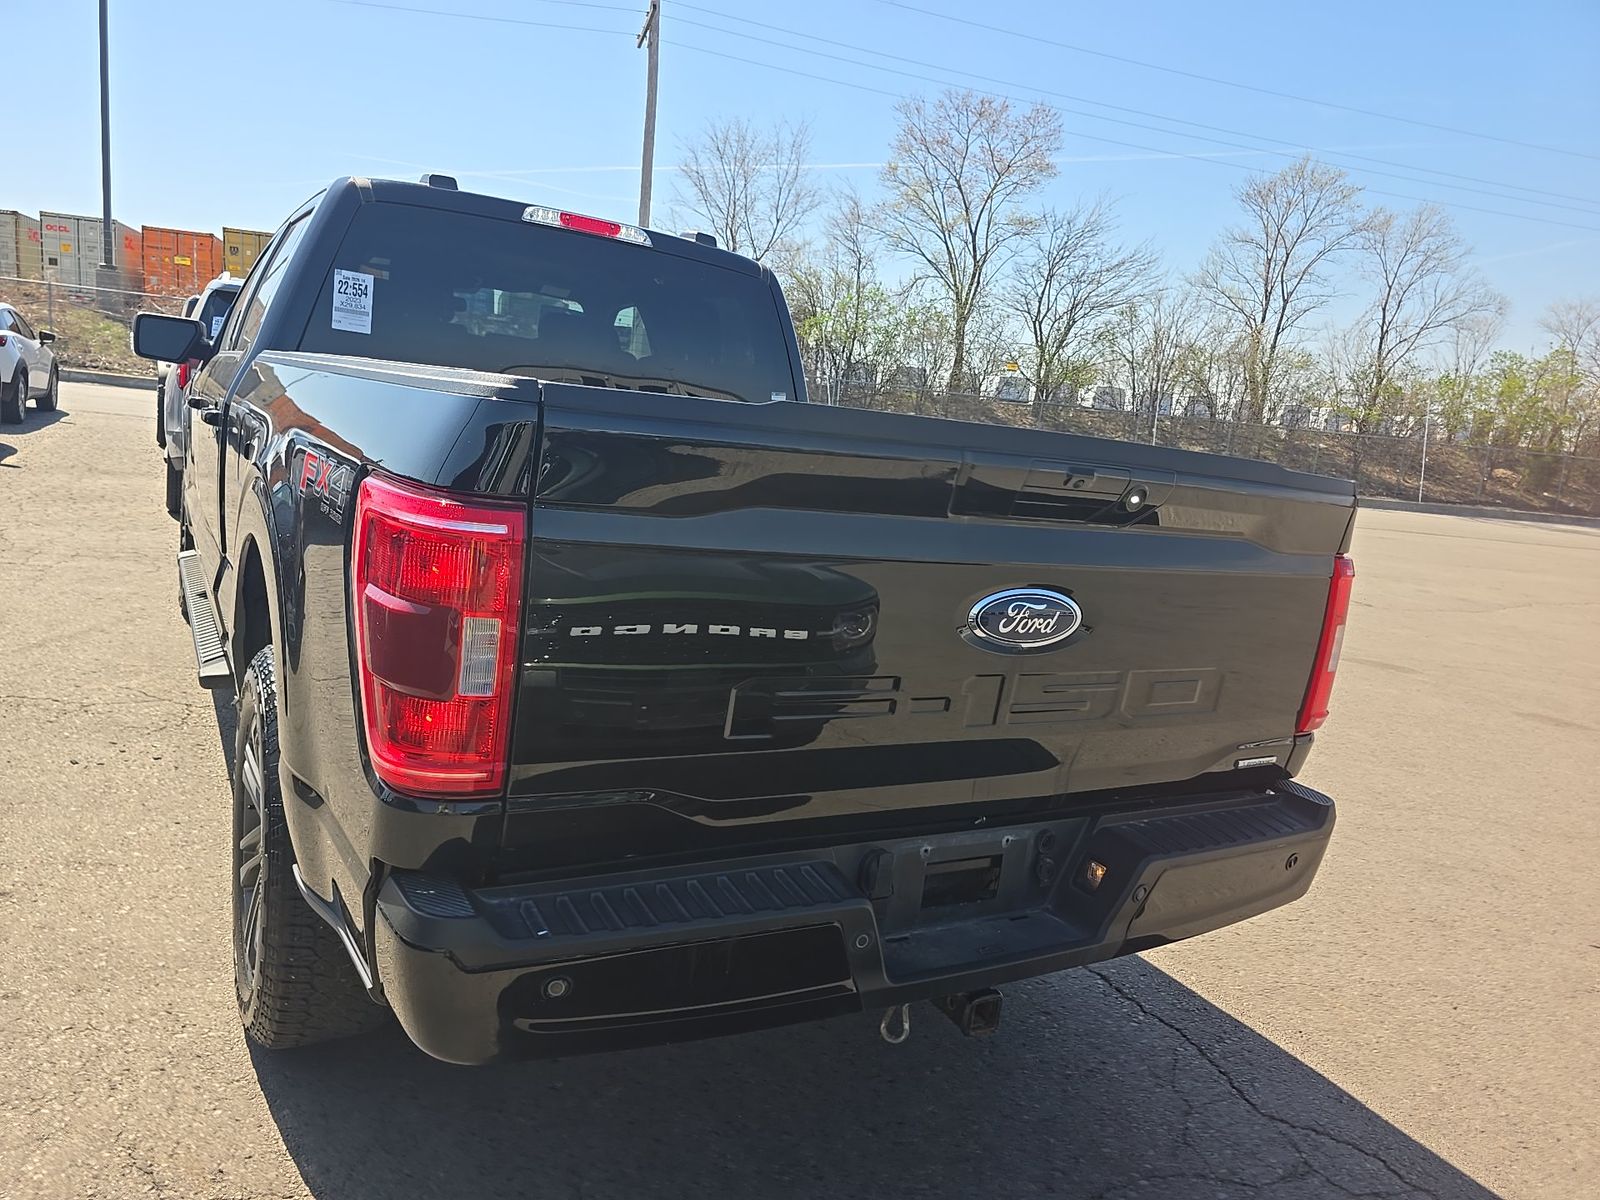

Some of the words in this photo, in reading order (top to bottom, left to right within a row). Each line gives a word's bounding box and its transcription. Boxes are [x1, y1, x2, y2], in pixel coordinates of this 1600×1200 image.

[338, 279, 369, 299] 22:554
[298, 450, 353, 514] FX4
[998, 601, 1060, 635] Ford
[722, 667, 1222, 741] F-150
